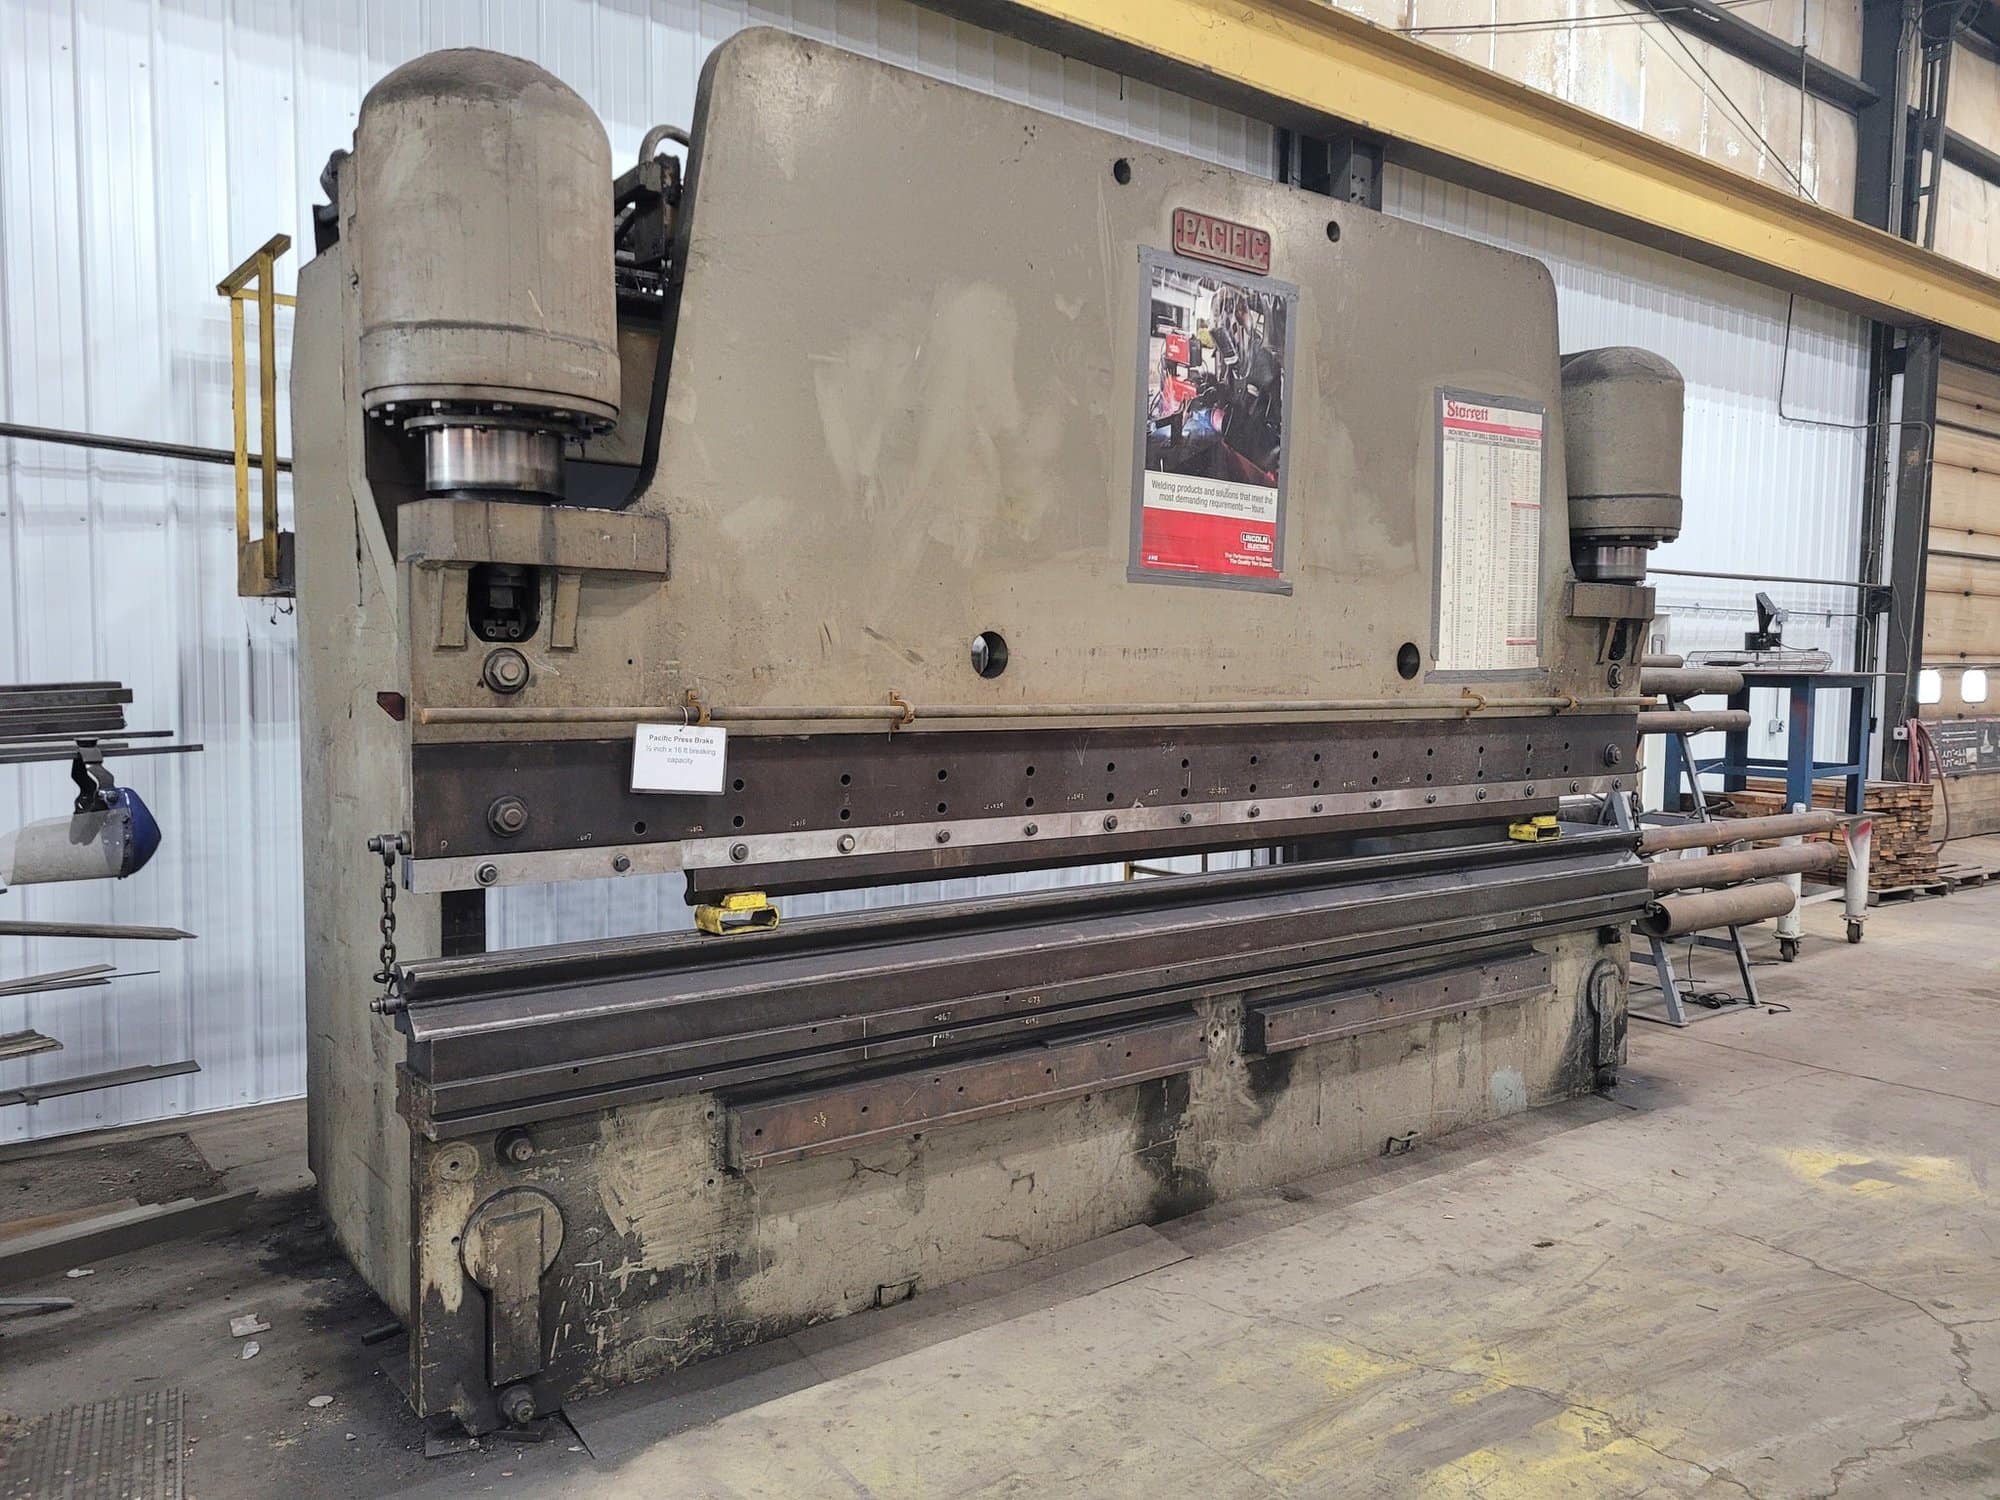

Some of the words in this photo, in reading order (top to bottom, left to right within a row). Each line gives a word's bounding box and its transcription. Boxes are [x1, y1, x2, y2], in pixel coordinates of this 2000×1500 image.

[1183, 212, 1267, 263] PACIFIC
[1448, 400, 1488, 420] Starrett
[1152, 480, 1176, 492] Welding
[1177, 483, 1202, 495] products
[1204, 487, 1215, 496] and
[1216, 488, 1238, 499] solutions
[1240, 492, 1251, 500] that
[1159, 493, 1174, 501] most
[1175, 494, 1208, 507] demanding
[1209, 500, 1244, 511] requirements
[649, 734, 672, 742] Pacific
